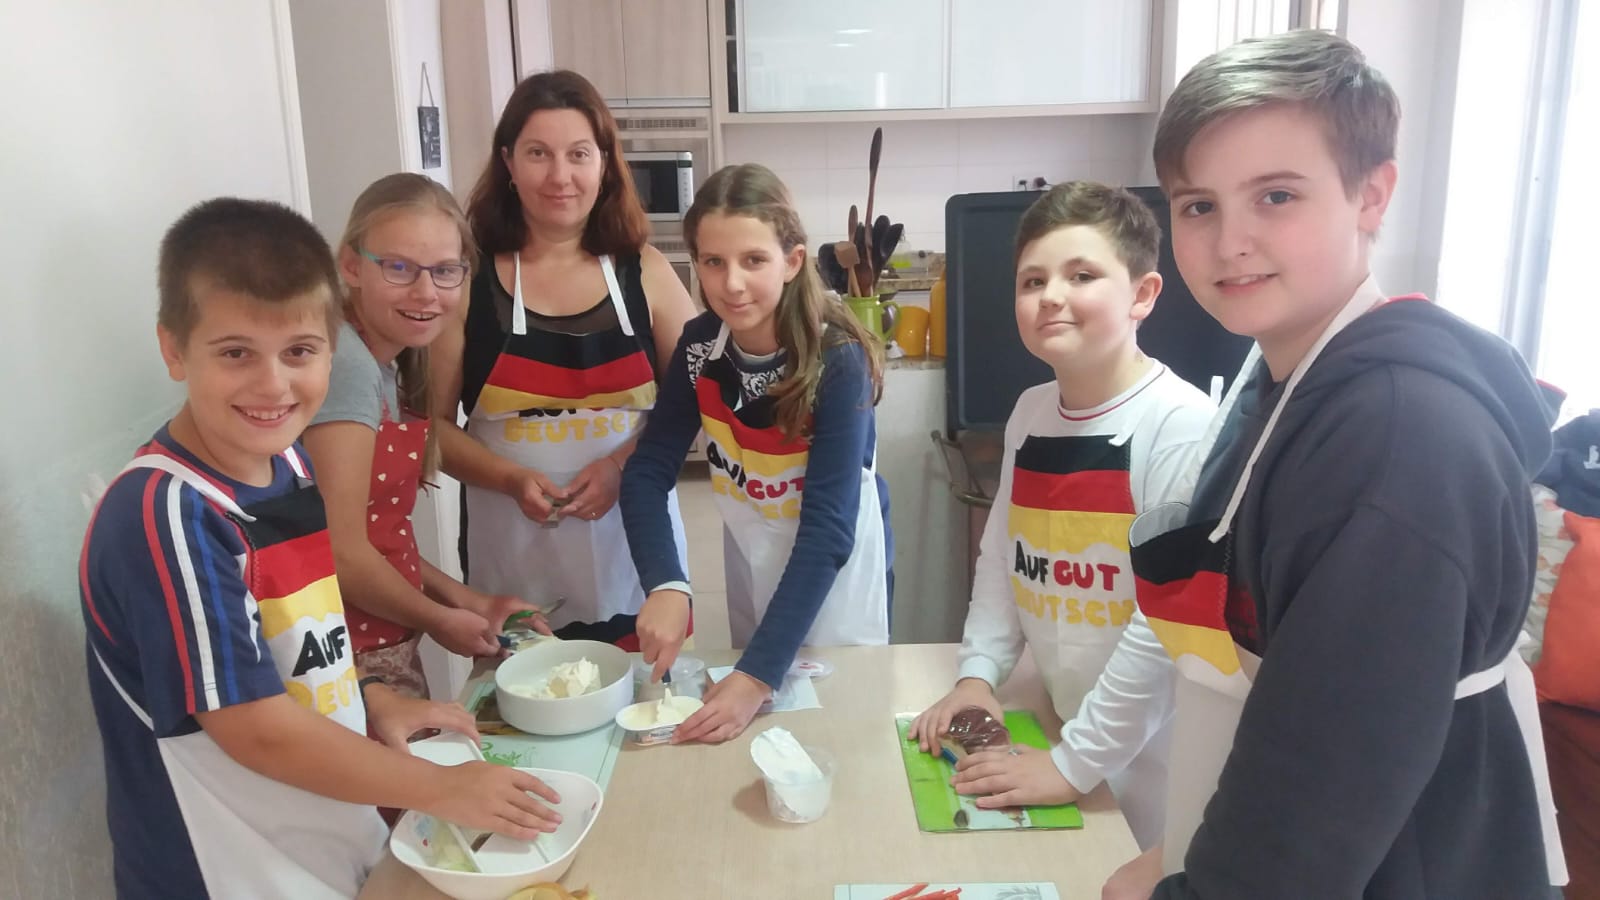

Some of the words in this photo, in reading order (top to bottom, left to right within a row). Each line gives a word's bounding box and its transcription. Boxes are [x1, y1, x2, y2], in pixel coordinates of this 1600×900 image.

[1015, 540, 1048, 585] AUF
[1053, 560, 1120, 591] GUT
[292, 626, 346, 677] AUF
